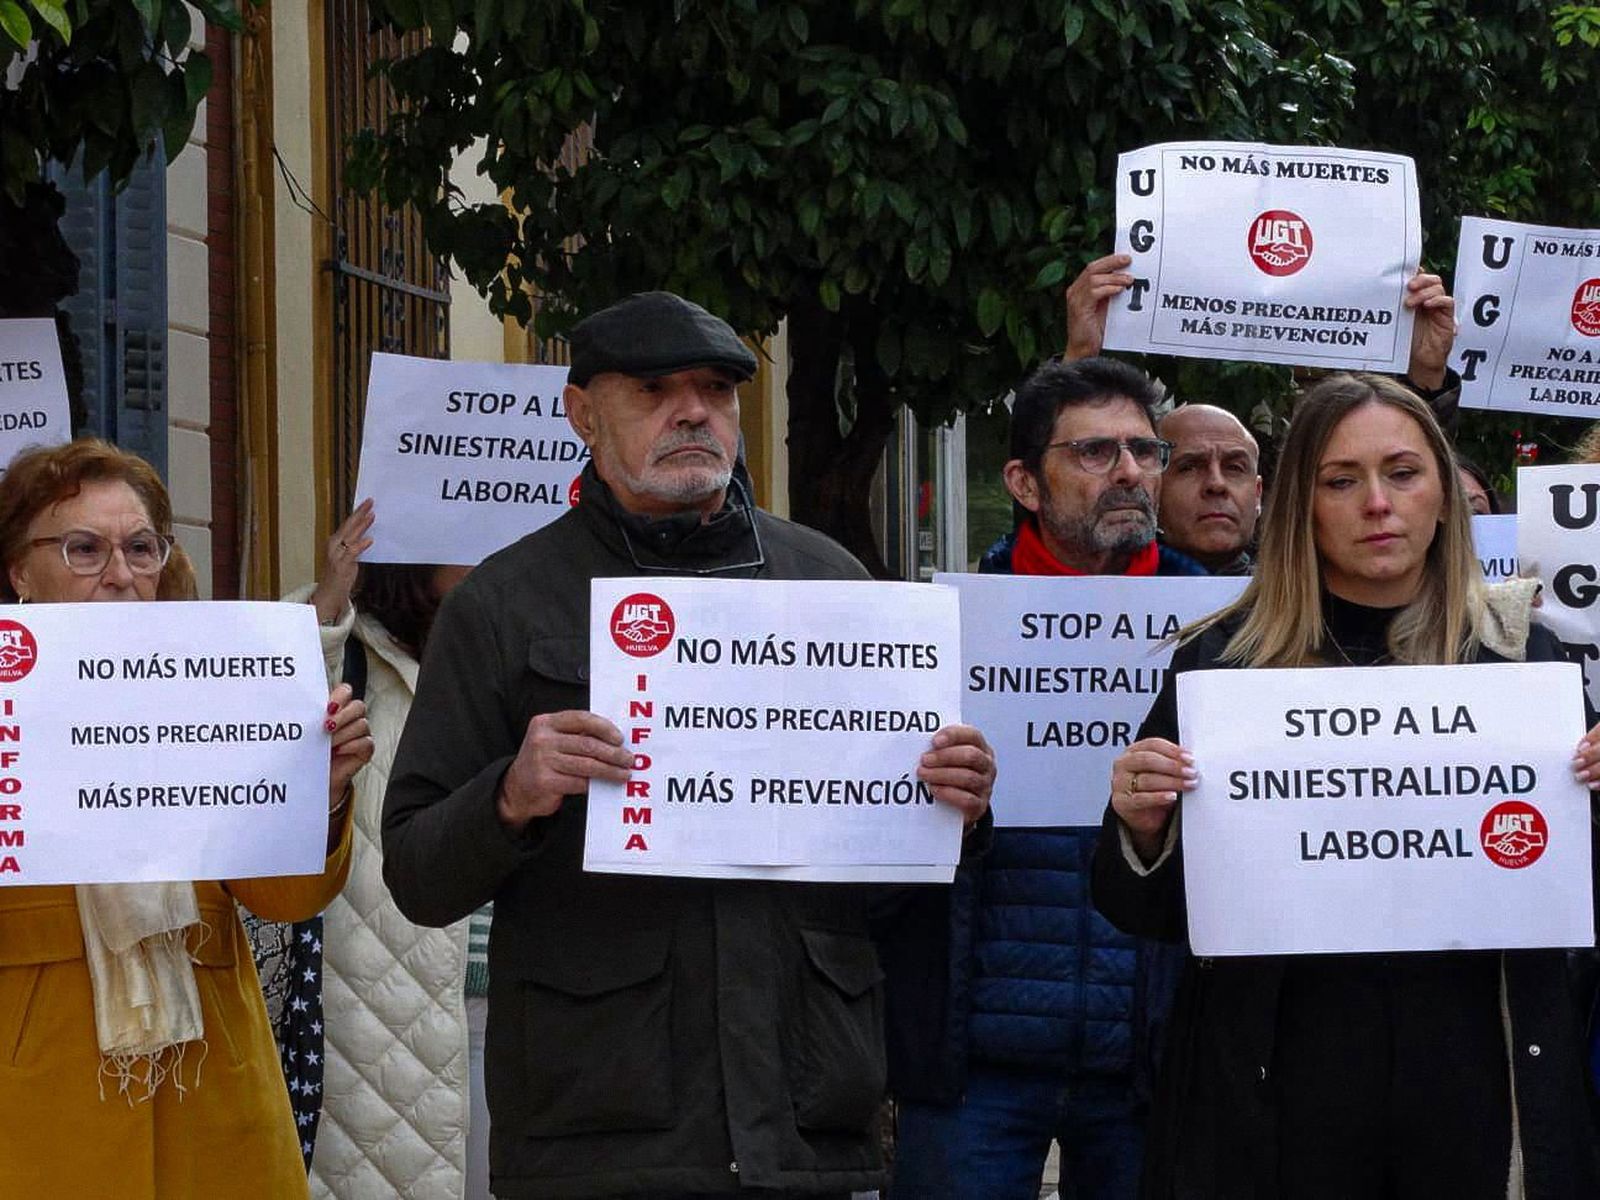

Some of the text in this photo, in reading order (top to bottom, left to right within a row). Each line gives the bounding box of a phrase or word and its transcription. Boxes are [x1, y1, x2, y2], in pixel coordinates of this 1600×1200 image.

[1181, 154, 1390, 183] NO MÁS MUERTES
[1127, 168, 1156, 312] UGT
[1256, 219, 1304, 245] UGT
[1533, 241, 1558, 255] NO
[1561, 242, 1593, 258] MÁS
[1161, 294, 1392, 326] MENOS PRECARIEDAD
[1461, 234, 1514, 381] UGT
[1181, 316, 1368, 347] MÁS PREVENCIÓN
[1547, 347, 1576, 362] NO
[1578, 349, 1593, 364] A
[0, 361, 42, 382] TES
[446, 391, 567, 418] STOP A L
[0, 411, 47, 430] DAD
[441, 479, 563, 505] LABORAL
[1480, 557, 1520, 577] MU
[622, 604, 661, 623] UGT
[1021, 613, 1180, 640] STOP A LA
[677, 633, 938, 669] NO MÁS MUERTES
[78, 653, 296, 680] NO MÁS MUERTES
[968, 665, 1168, 693] SINIESTRALI
[665, 706, 940, 733] MENOS PRECARIEDAD
[1285, 705, 1477, 738] STOP A LA
[71, 722, 303, 745] MENOS PRECARIEDAD
[1026, 720, 1142, 747] LABOR
[623, 675, 652, 851] INFORMA
[78, 779, 287, 809] MÁS PREVENCIÓN
[667, 771, 934, 806] MÁS PREVENCIÓN
[1229, 764, 1537, 801] SINIESTRALIDAD
[1493, 814, 1534, 833] UGT
[1300, 827, 1473, 861] LABORAL
